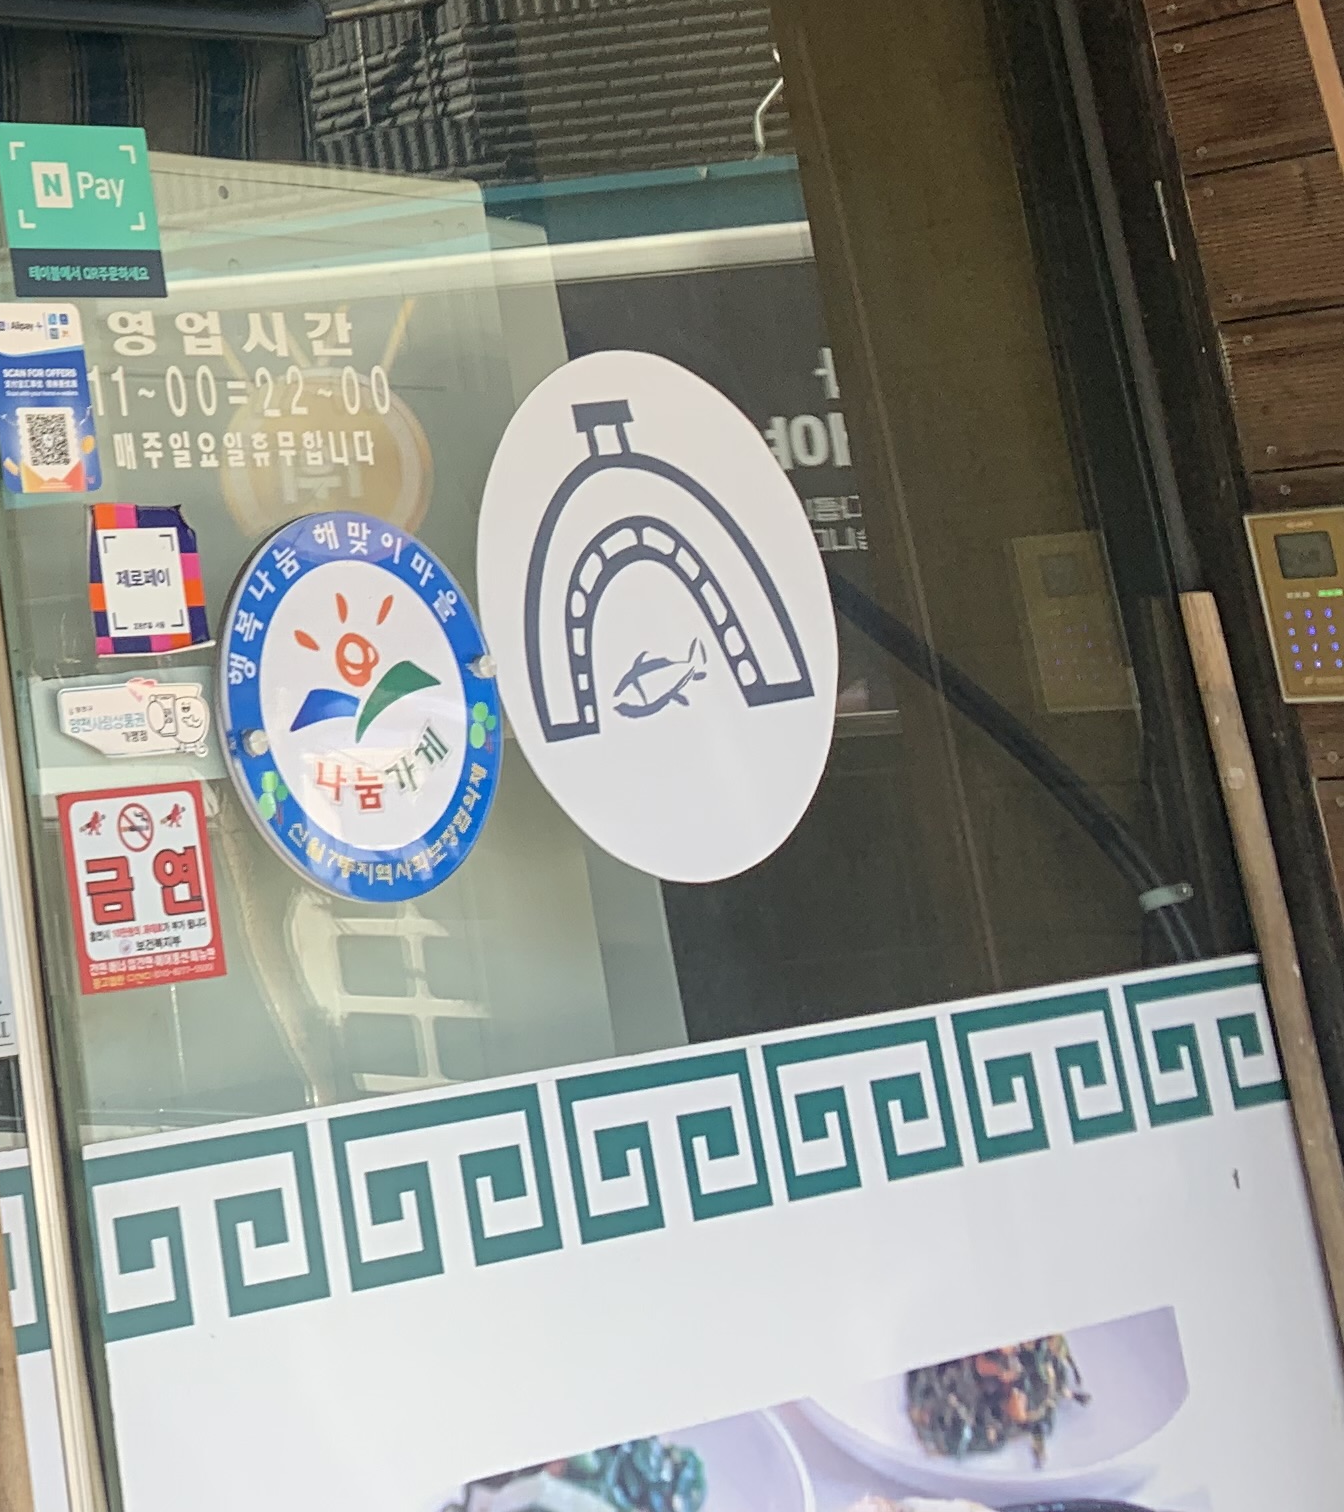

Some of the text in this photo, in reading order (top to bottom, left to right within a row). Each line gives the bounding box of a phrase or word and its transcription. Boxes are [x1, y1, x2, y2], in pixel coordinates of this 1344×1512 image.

[76, 171, 125, 208] Pay
[107, 307, 355, 359] 영업시간
[2, 368, 28, 379] SCAN
[27, 368, 45, 378] FOR
[115, 567, 173, 590] 제로페이
[135, 935, 182, 952] 보건복지부
